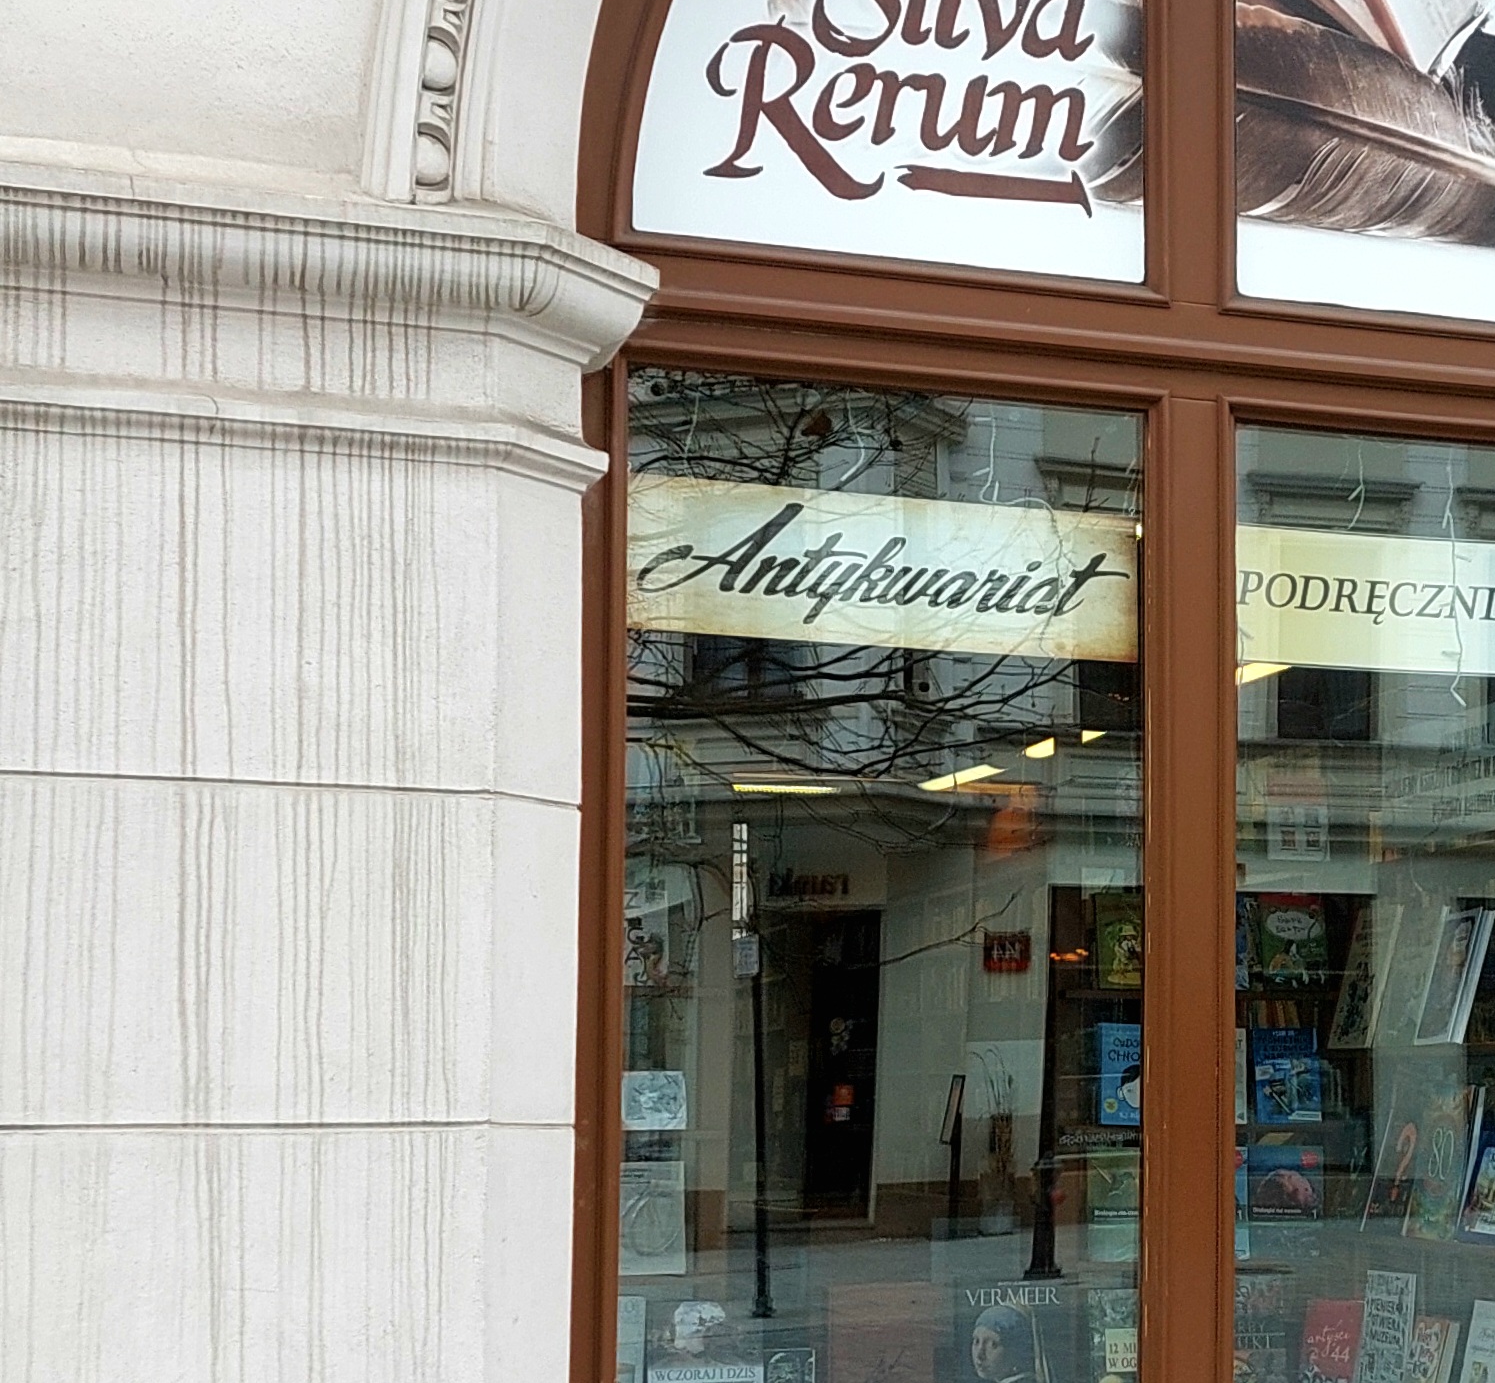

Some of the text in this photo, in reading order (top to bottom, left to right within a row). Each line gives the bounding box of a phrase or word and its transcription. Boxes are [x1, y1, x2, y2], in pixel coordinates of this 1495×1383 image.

[703, 15, 1094, 200] Rerum
[636, 502, 1132, 625] Antykwariat
[966, 1287, 1060, 1307] VERMEER
[655, 1368, 716, 1381] WCZORAJ
